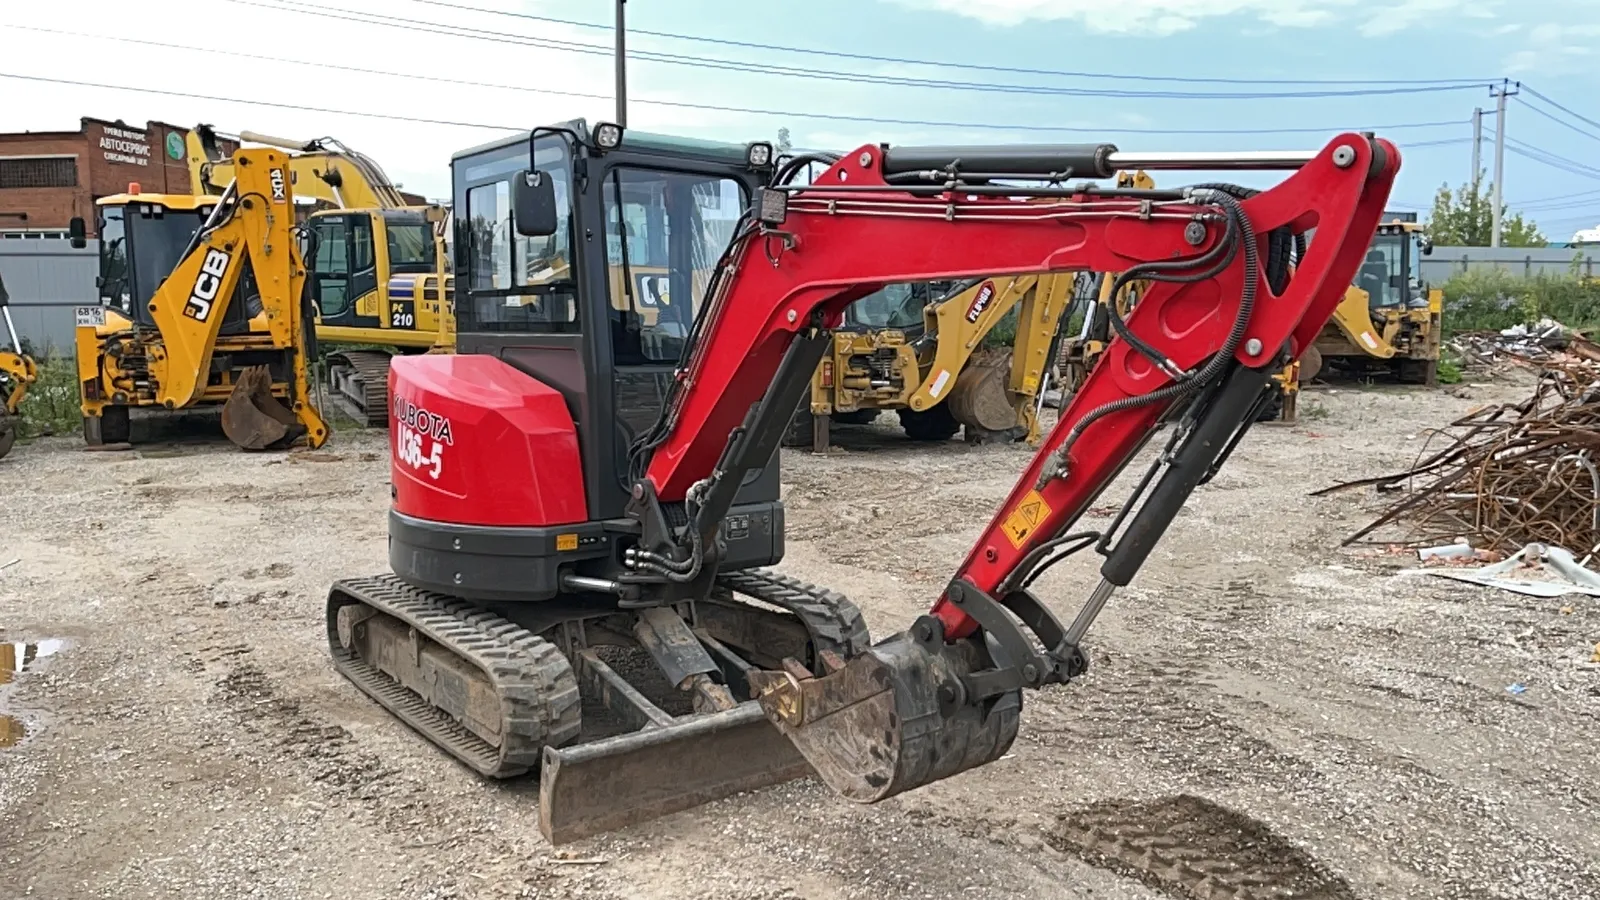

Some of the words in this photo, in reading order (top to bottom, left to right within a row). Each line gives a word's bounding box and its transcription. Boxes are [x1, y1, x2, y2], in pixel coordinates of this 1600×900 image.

[99, 137, 151, 157] АВТОСЕРВИС
[103, 151, 136, 164] СЛЕСАРНЫЙ
[136, 158, 148, 166] ЦЕХ
[270, 169, 285, 199] 4CX
[189, 249, 229, 320] JCB
[392, 302, 404, 313] PC
[393, 313, 414, 327] 210
[394, 393, 454, 446] KUBOTA
[398, 421, 443, 480] U36-5
